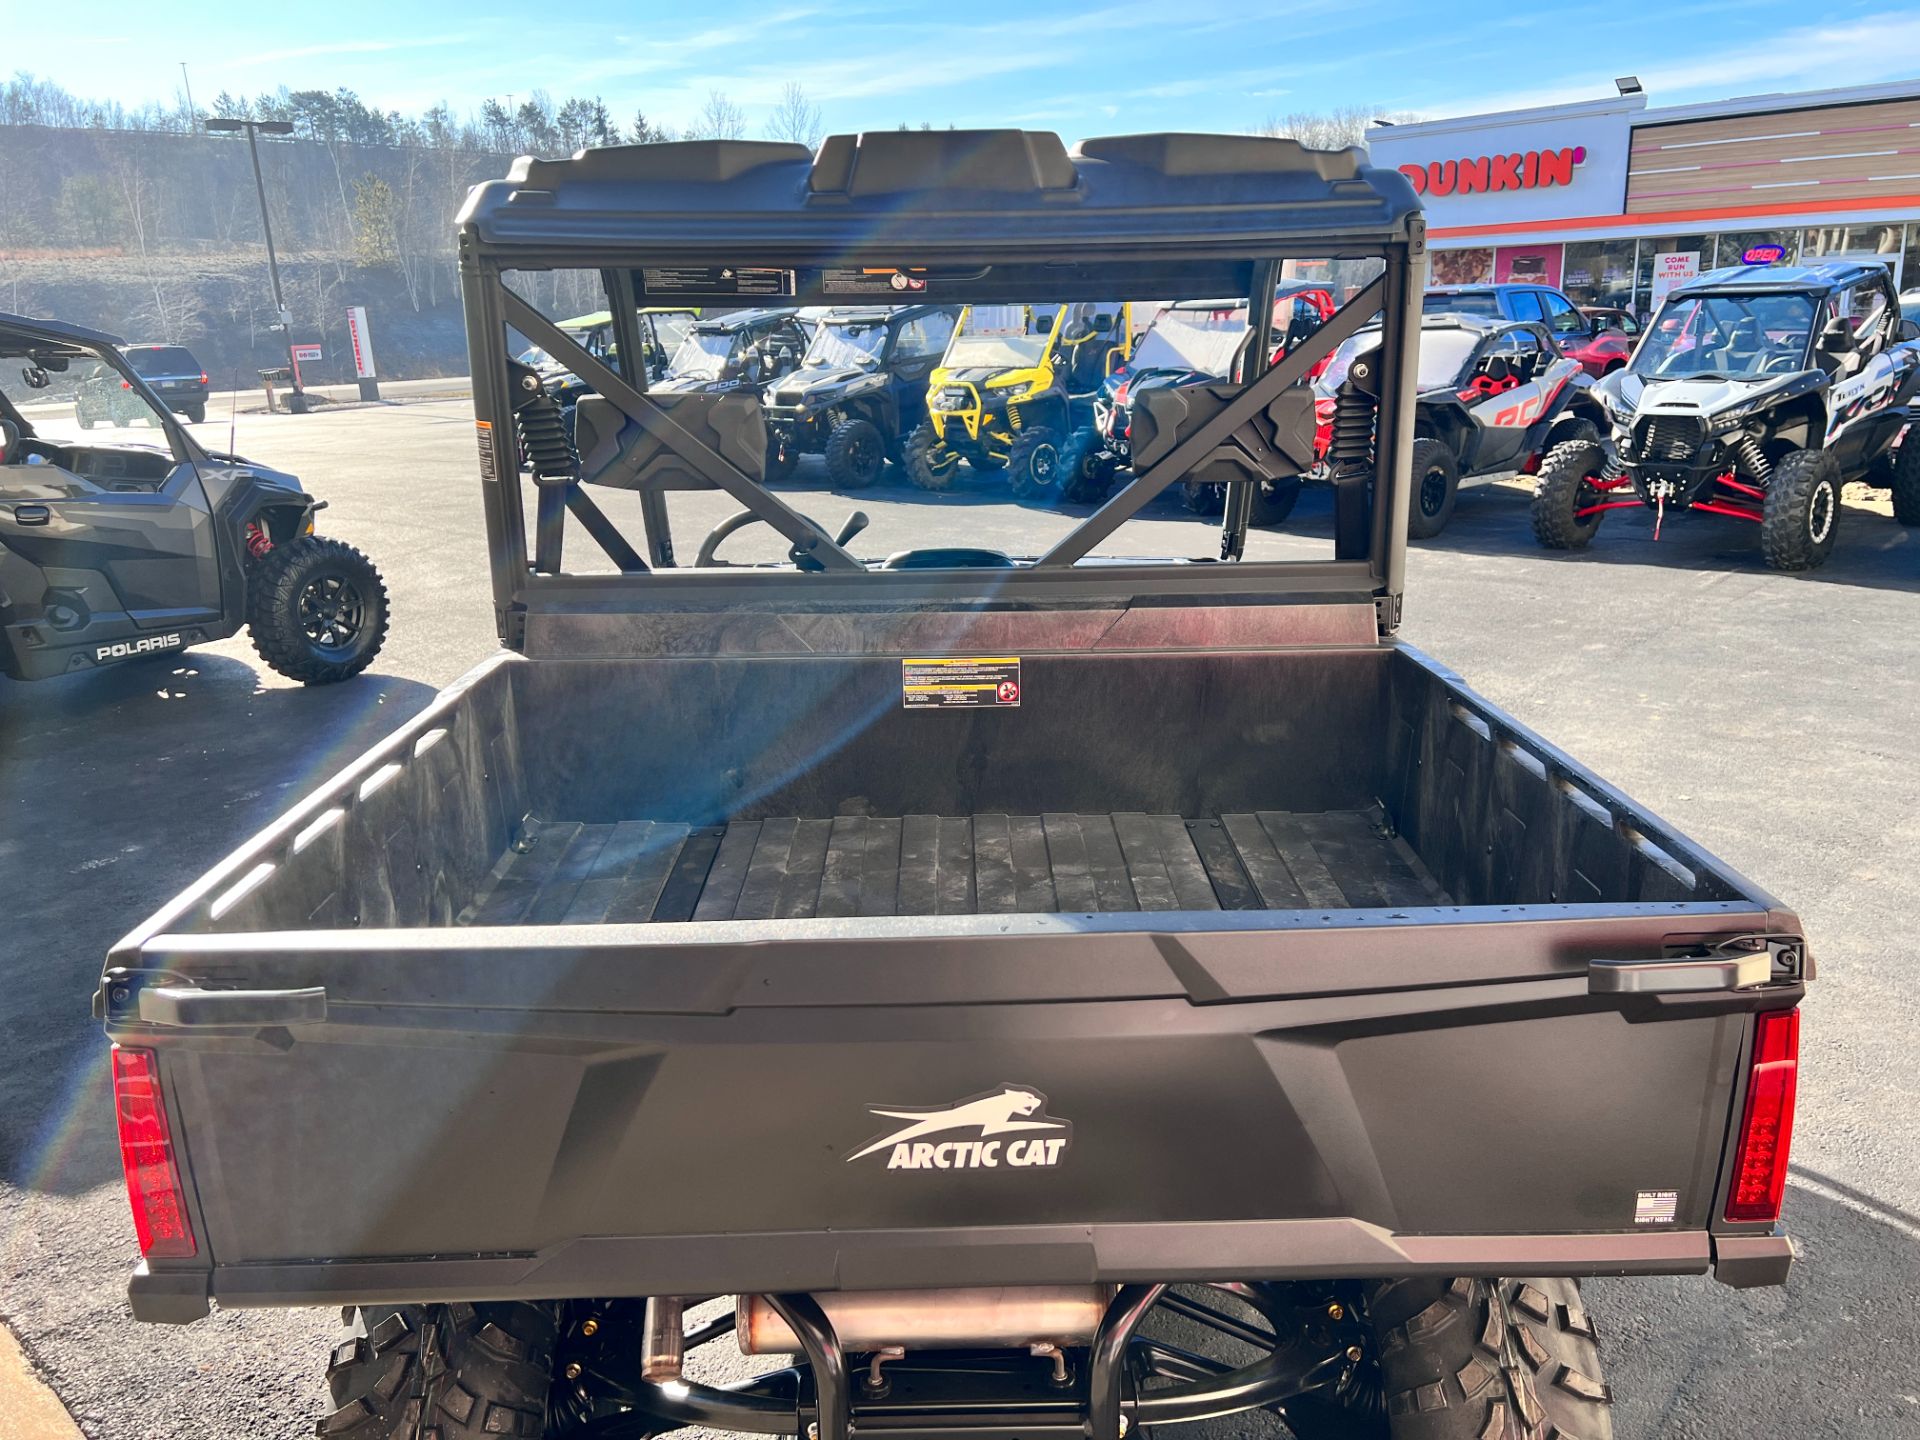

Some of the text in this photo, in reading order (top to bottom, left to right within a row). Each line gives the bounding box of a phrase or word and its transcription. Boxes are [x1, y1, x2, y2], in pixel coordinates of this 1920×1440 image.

[1664, 256, 1691, 264] COME
[1744, 248, 1781, 262] OPEN
[1658, 271, 1681, 279] WITH
[96, 632, 181, 661] POLARIS
[887, 1138, 1066, 1170] ARCTIC CAT
